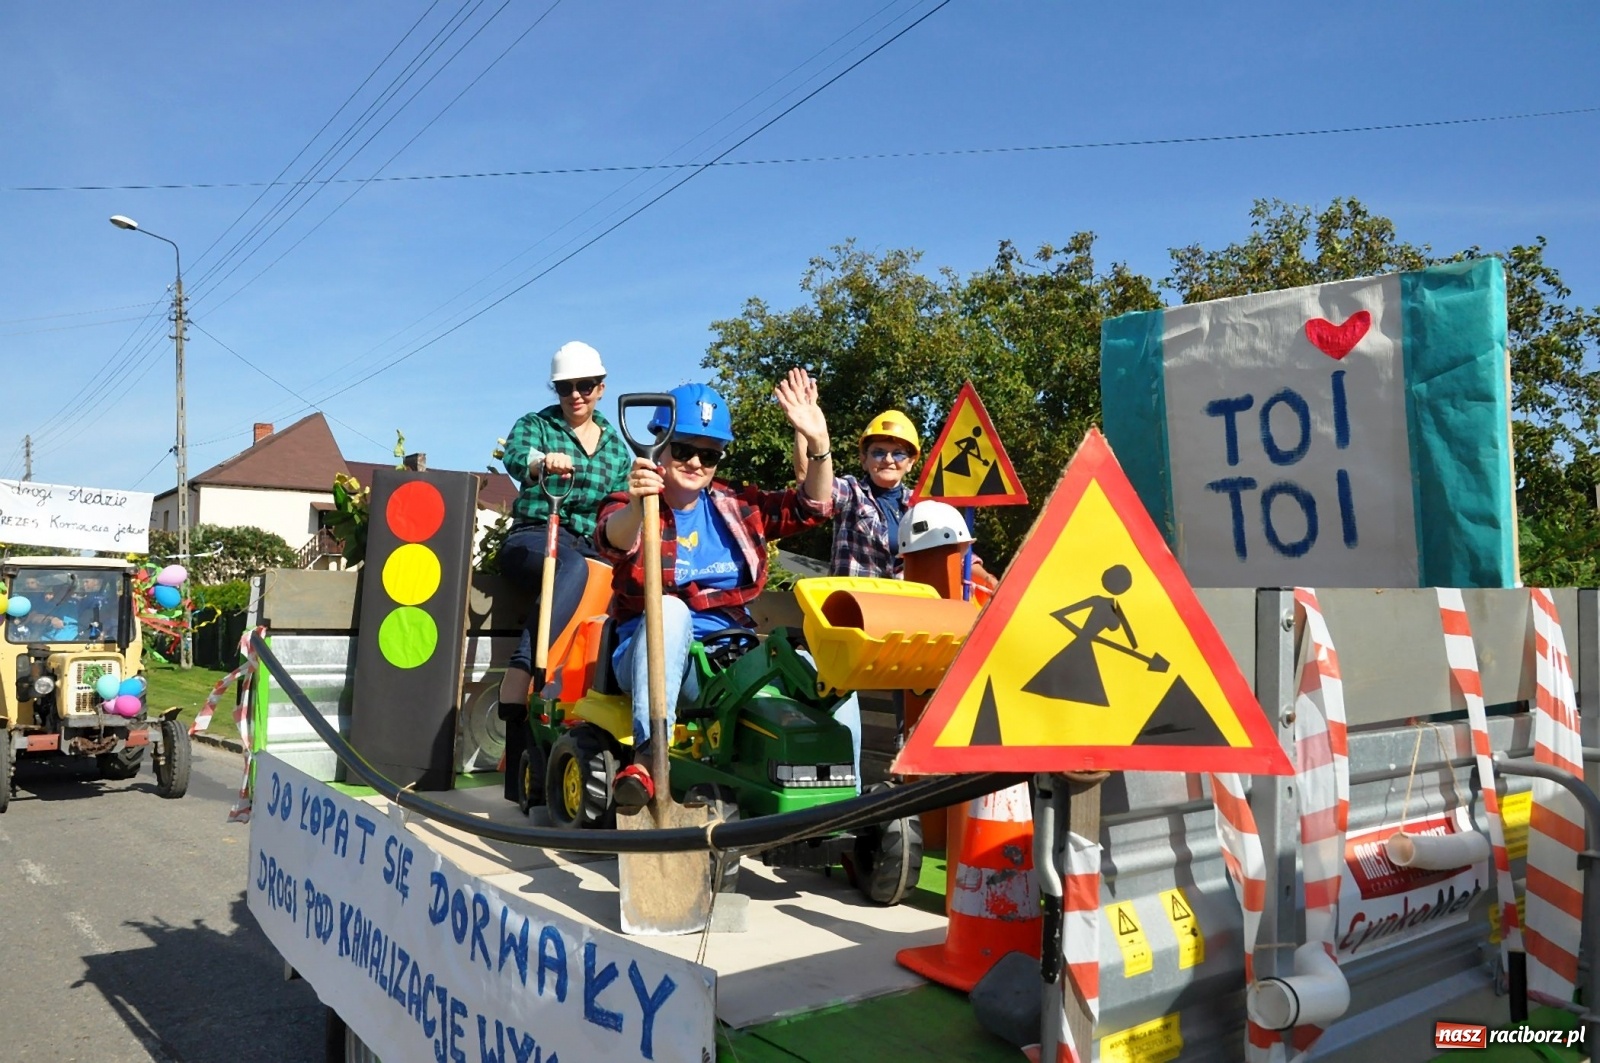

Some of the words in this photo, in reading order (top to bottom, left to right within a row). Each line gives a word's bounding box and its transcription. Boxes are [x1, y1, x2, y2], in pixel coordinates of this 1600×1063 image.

[1201, 370, 1350, 466] TOI
[1204, 469, 1358, 562] TOI
[257, 848, 297, 923] DROGI
[304, 878, 334, 945] POD
[338, 902, 468, 1063] KANALIZACJE
[267, 772, 293, 821] DO
[383, 835, 414, 907] SIĘ
[428, 871, 678, 1061] DORWAŁY
